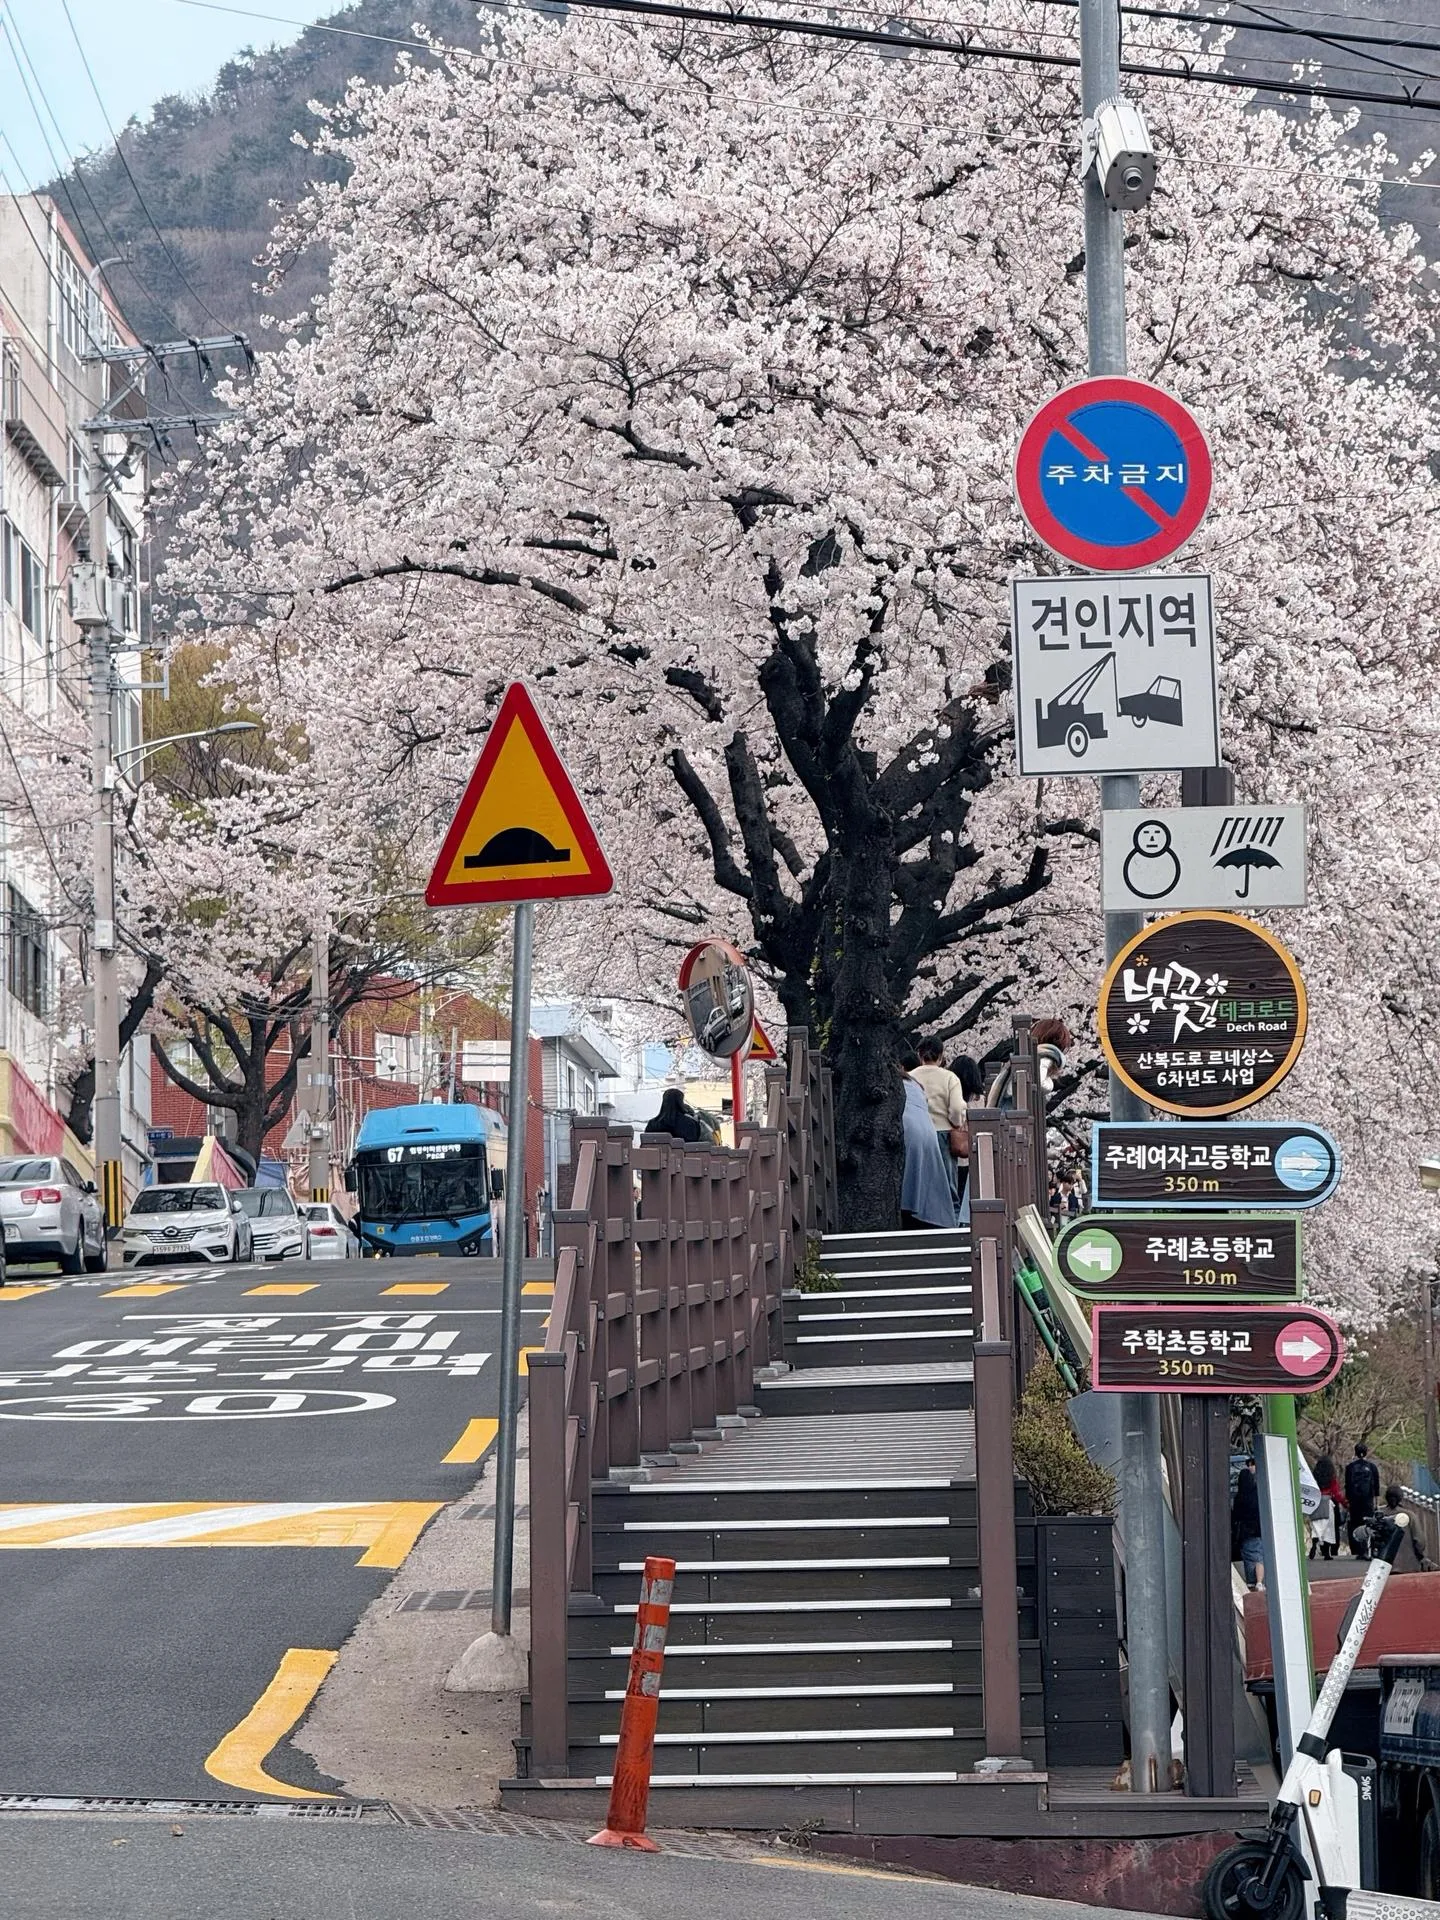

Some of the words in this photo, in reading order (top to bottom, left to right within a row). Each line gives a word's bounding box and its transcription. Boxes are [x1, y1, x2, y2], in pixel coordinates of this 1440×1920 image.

[1046, 463, 1185, 486] 주차금지
[1031, 592, 1197, 651] 견인지역
[1219, 1000, 1295, 1022] 데크로드
[1227, 1022, 1256, 1032] Dech
[1258, 1021, 1288, 1032] Road
[1137, 1052, 1204, 1070] 산복도로
[1208, 1049, 1275, 1066] 르네상스
[1157, 1069, 1218, 1088] 6차년도
[1222, 1069, 1255, 1086] 사업
[387, 1147, 405, 1163] 67
[1105, 1145, 1272, 1170] 주례여자고등학교
[1164, 1176, 1199, 1192] 350
[1202, 1180, 1220, 1192] m
[1145, 1237, 1275, 1262] 주례초등학교
[1183, 1270, 1216, 1285] 150
[1220, 1274, 1237, 1285] m
[52, 1331, 460, 1357] 어린이
[1122, 1330, 1252, 1355] 주학초등학교
[1158, 1360, 1193, 1376] 350
[1197, 1363, 1214, 1376] m
[33, 1394, 306, 1416] 30
[1361, 1776, 1372, 1801] SWING
